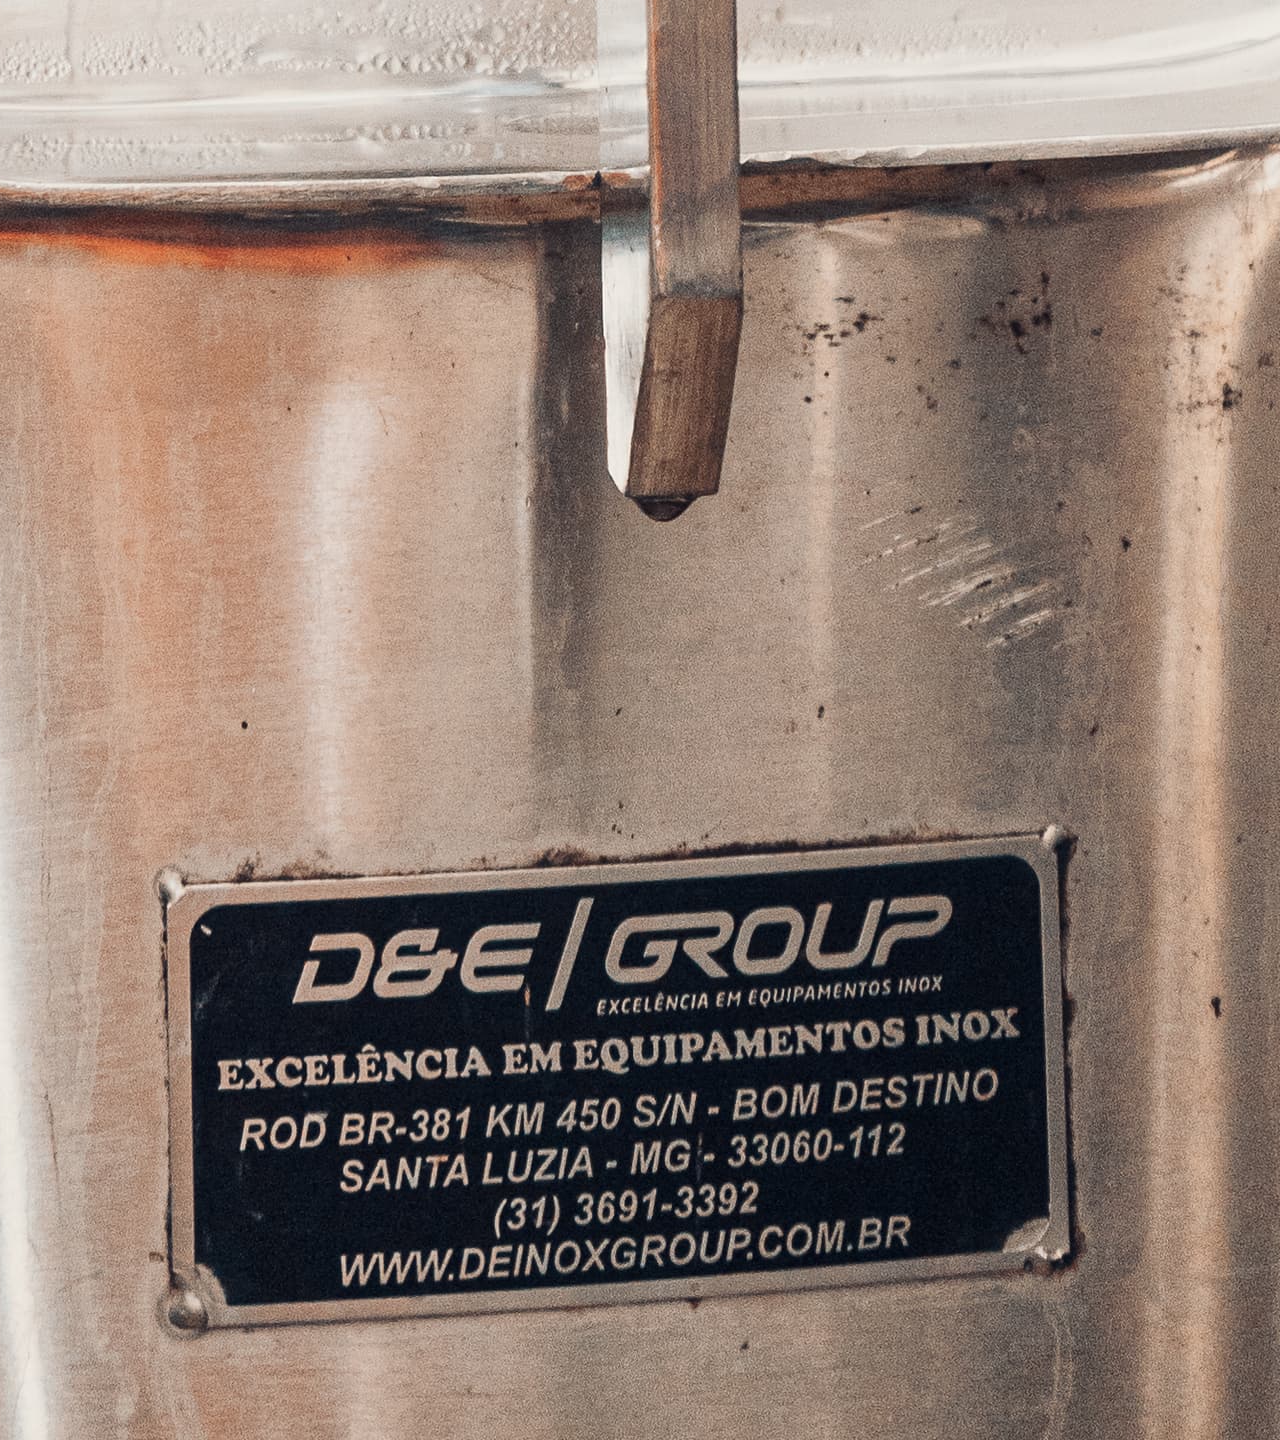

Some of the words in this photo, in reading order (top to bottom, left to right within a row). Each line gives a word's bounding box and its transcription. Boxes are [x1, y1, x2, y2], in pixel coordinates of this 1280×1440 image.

[292, 923, 541, 1005] D&E
[605, 894, 953, 984] GROUP
[597, 992, 709, 1016] EXCELÊNCIA
[715, 991, 742, 1008] EM
[748, 979, 891, 1007] EQUIPAMENTOS
[898, 975, 943, 993] INOX
[217, 1043, 492, 1091] EXCELÊNCIA
[501, 1041, 562, 1075] EM
[572, 1017, 905, 1075] EQUIPAMENTOS
[915, 1007, 1020, 1045] INOX
[239, 1113, 328, 1151] ROD
[338, 1106, 471, 1146] BR-381
[485, 1101, 545, 1138] KM
[556, 1097, 622, 1133] 450
[633, 1091, 698, 1128] S/N
[732, 1083, 820, 1121] BOM
[832, 1068, 999, 1113] DESTINO
[339, 1153, 469, 1193] SANTA
[481, 1146, 593, 1185] LUZIA
[630, 1139, 691, 1175] MG
[727, 1122, 906, 1168] 33060-112
[493, 1195, 561, 1239] (31)
[574, 1180, 759, 1225] 3691-3392
[339, 1215, 912, 1287] WWW.DEINOXGROUP.COM.BR
